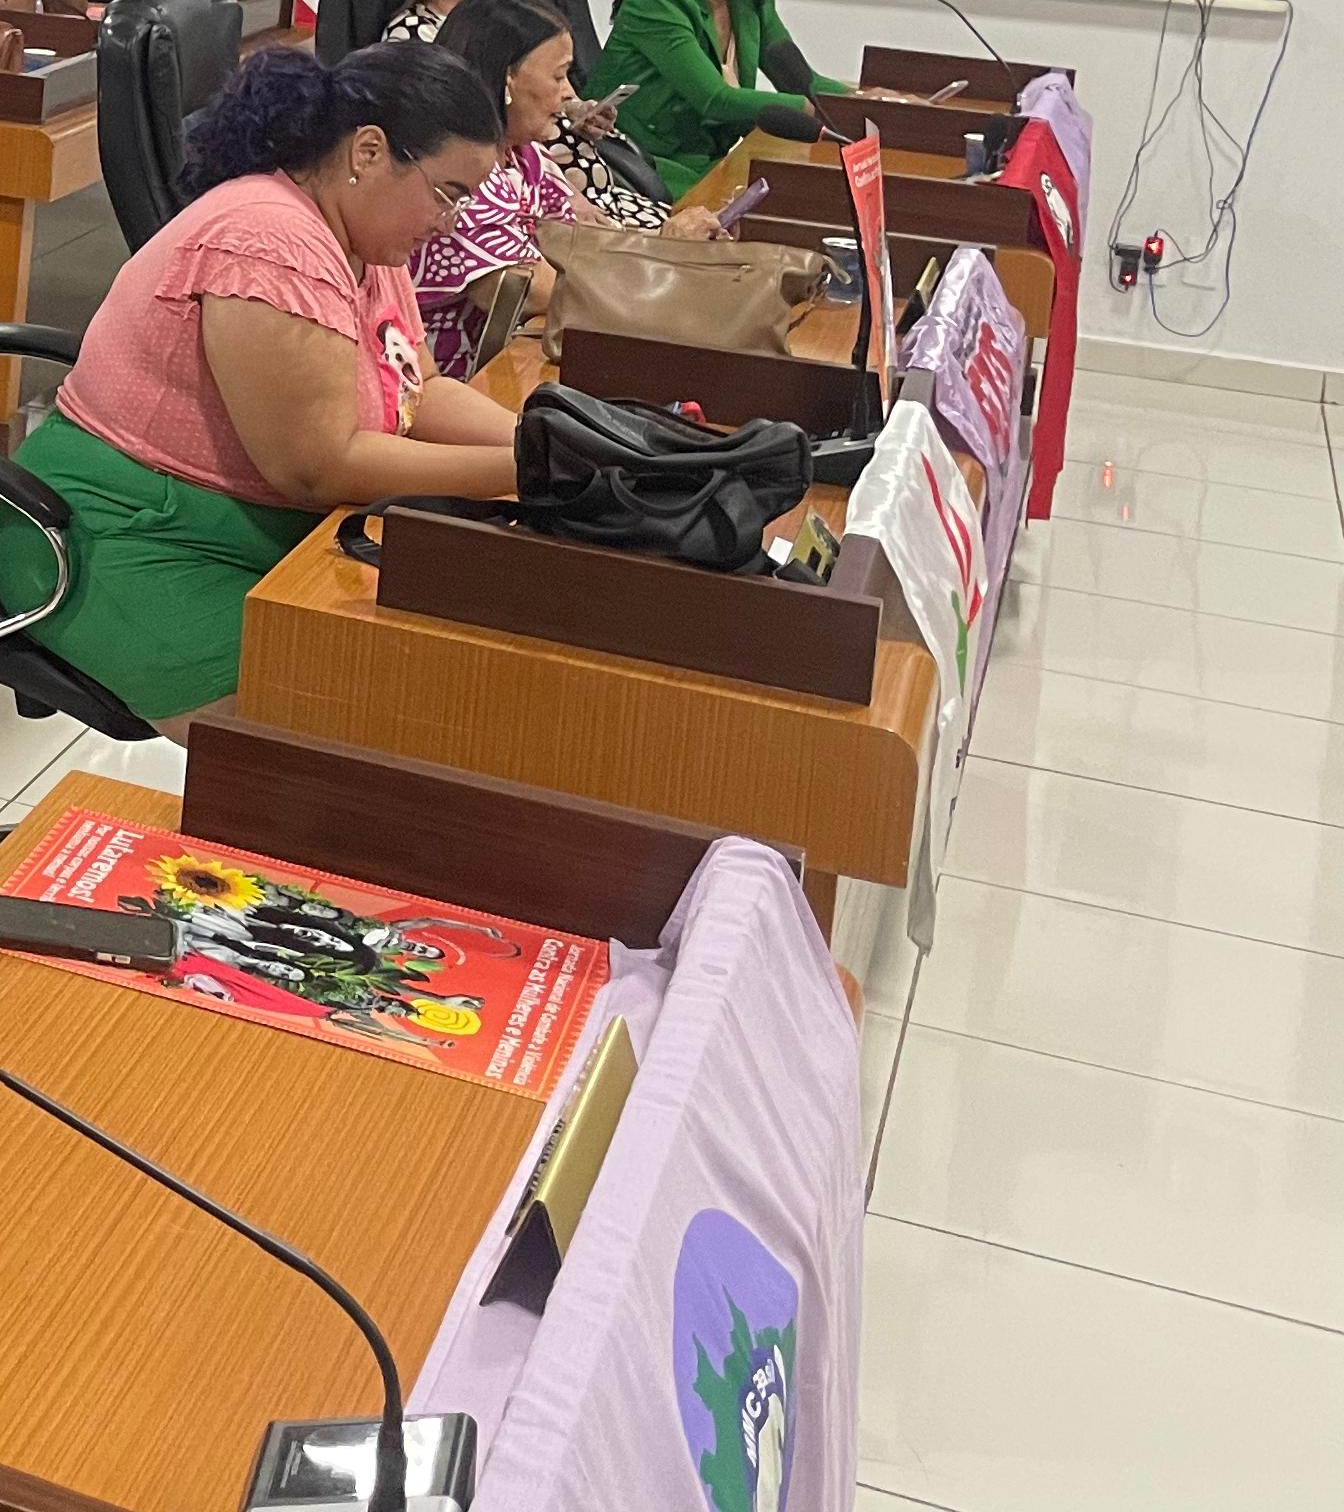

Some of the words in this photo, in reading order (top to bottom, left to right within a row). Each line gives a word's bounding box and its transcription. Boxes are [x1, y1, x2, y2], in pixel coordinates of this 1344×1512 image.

[67, 828, 145, 903] Lutaremos!
[532, 938, 565, 970] Contra
[527, 968, 548, 983] as
[507, 981, 547, 1028] Mulheres
[505, 1026, 522, 1036] e
[484, 1033, 523, 1080] Meninas
